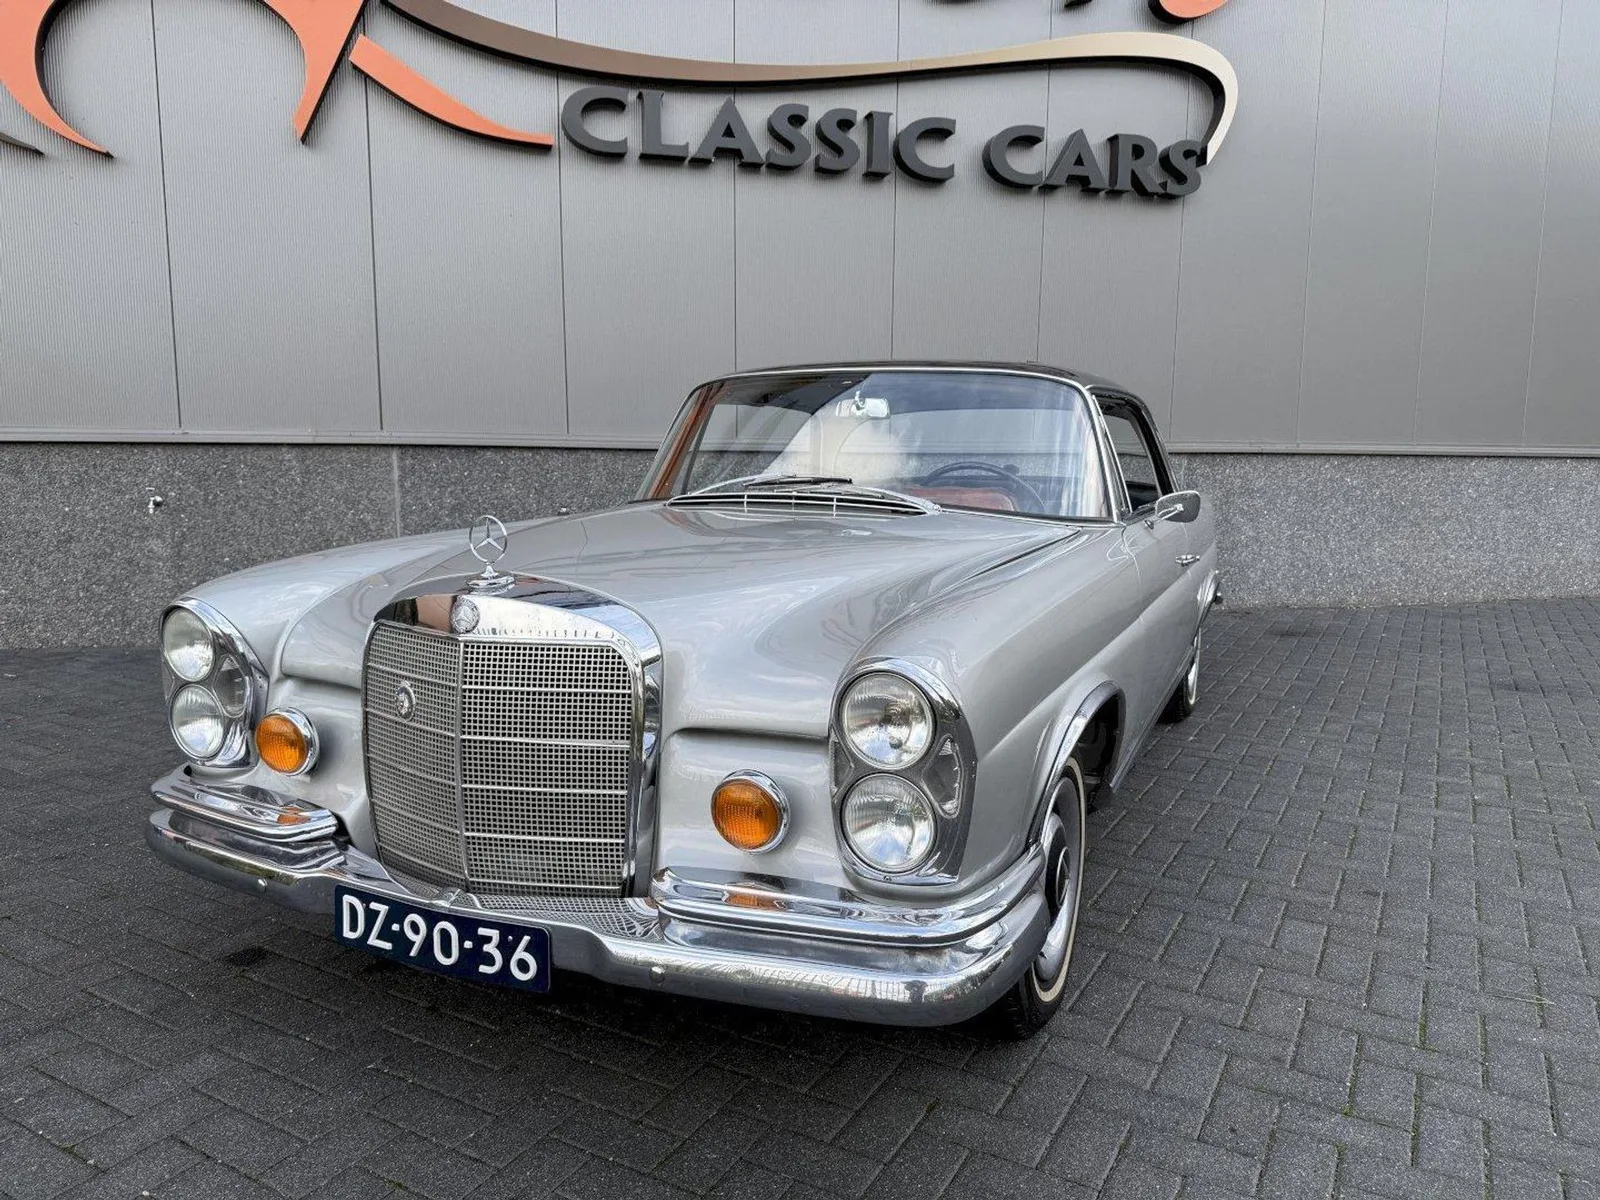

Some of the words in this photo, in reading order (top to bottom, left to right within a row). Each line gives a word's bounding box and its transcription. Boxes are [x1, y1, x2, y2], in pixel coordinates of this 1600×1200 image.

[561, 85, 956, 184] CLASSIC
[982, 124, 1207, 198] CARS
[342, 894, 538, 981] DZ-90-36
